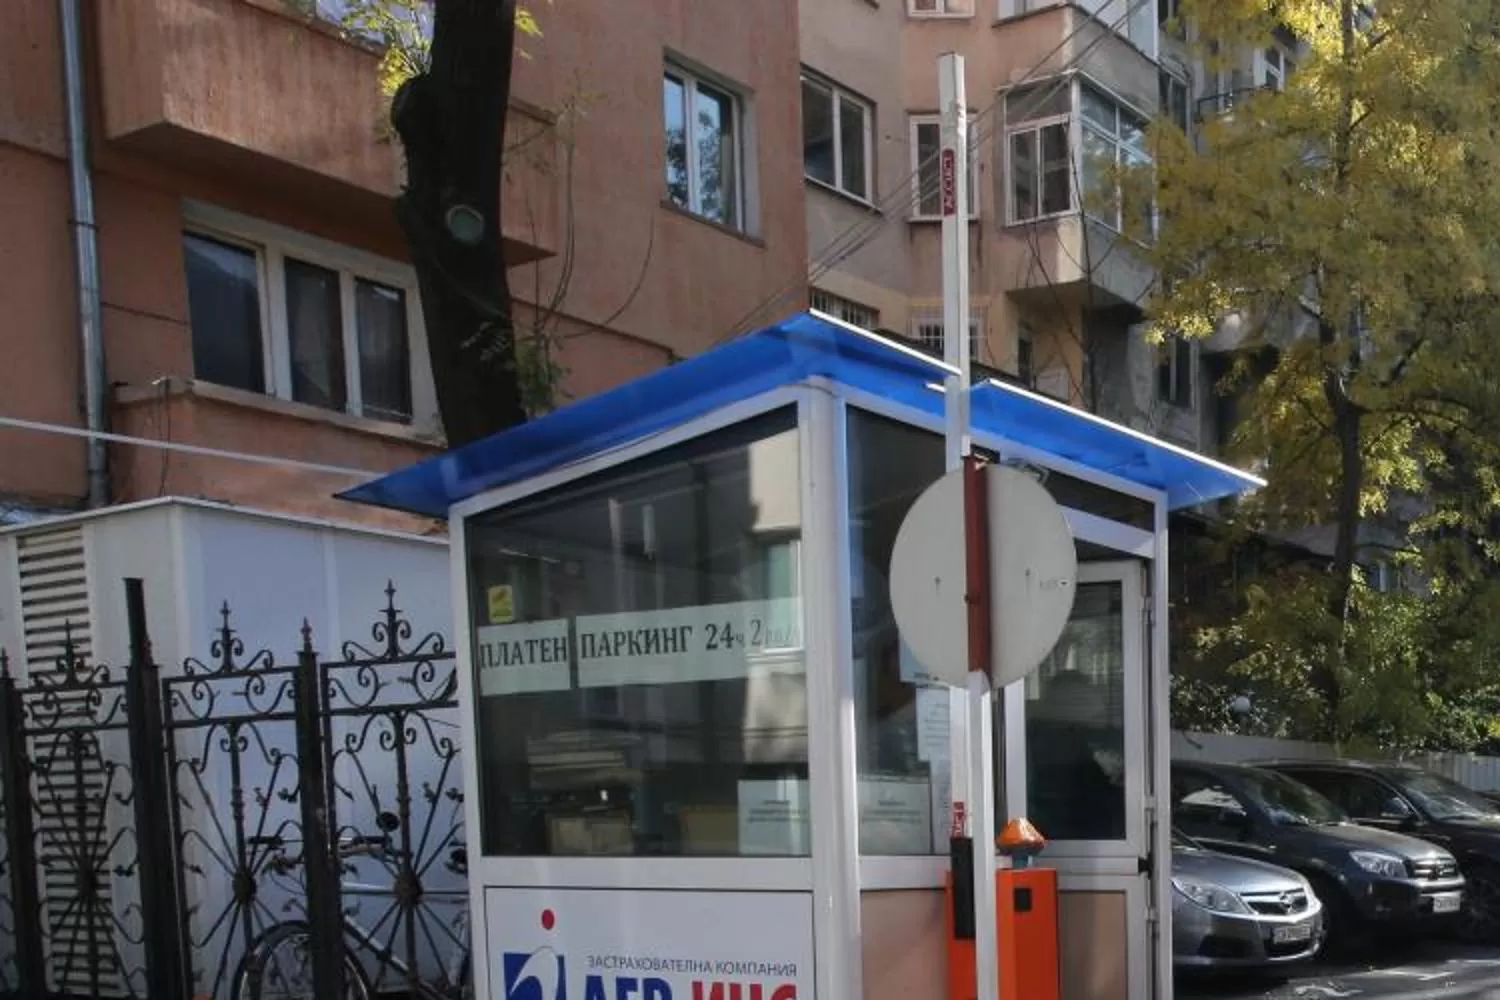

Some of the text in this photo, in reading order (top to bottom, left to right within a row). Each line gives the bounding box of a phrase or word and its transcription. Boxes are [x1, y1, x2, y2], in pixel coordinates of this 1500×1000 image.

[479, 634, 568, 669] ПЛАТЕН
[581, 625, 692, 660] ПАРКИНГ
[587, 955, 798, 978] ЗАСТРАХОВАТЕЛНА КОМПАНИЯ
